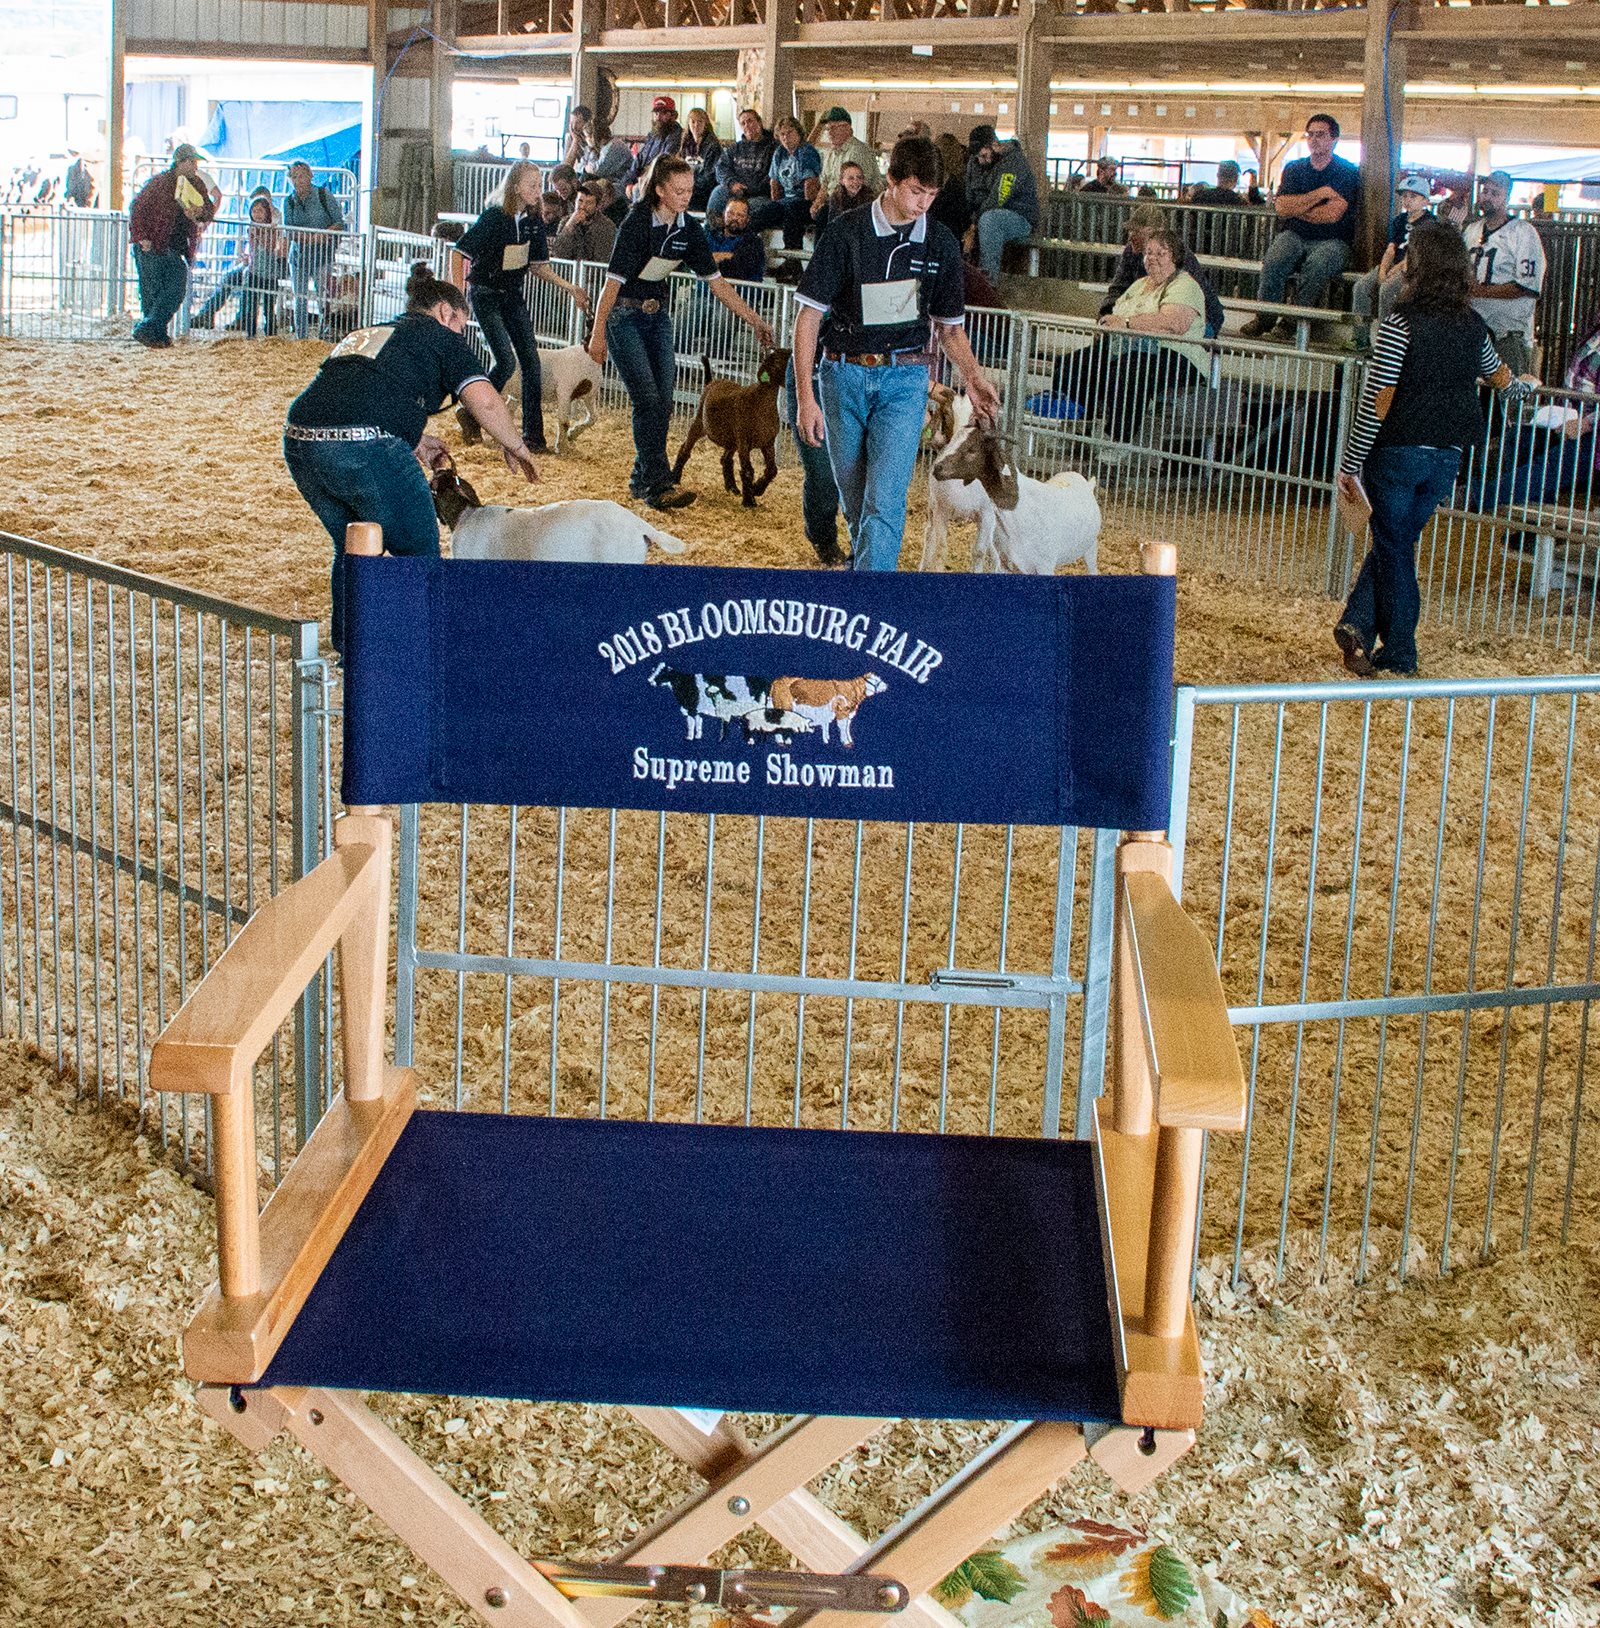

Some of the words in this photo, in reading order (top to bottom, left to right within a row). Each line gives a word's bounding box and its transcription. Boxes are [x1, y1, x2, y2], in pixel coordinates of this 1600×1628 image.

[1520, 258, 1536, 277] 31
[598, 621, 663, 675] 2018
[658, 599, 870, 651] BLOOMSBURG
[866, 621, 943, 684] FAIR
[633, 746, 751, 790] Supreme
[766, 752, 895, 788] Showman
